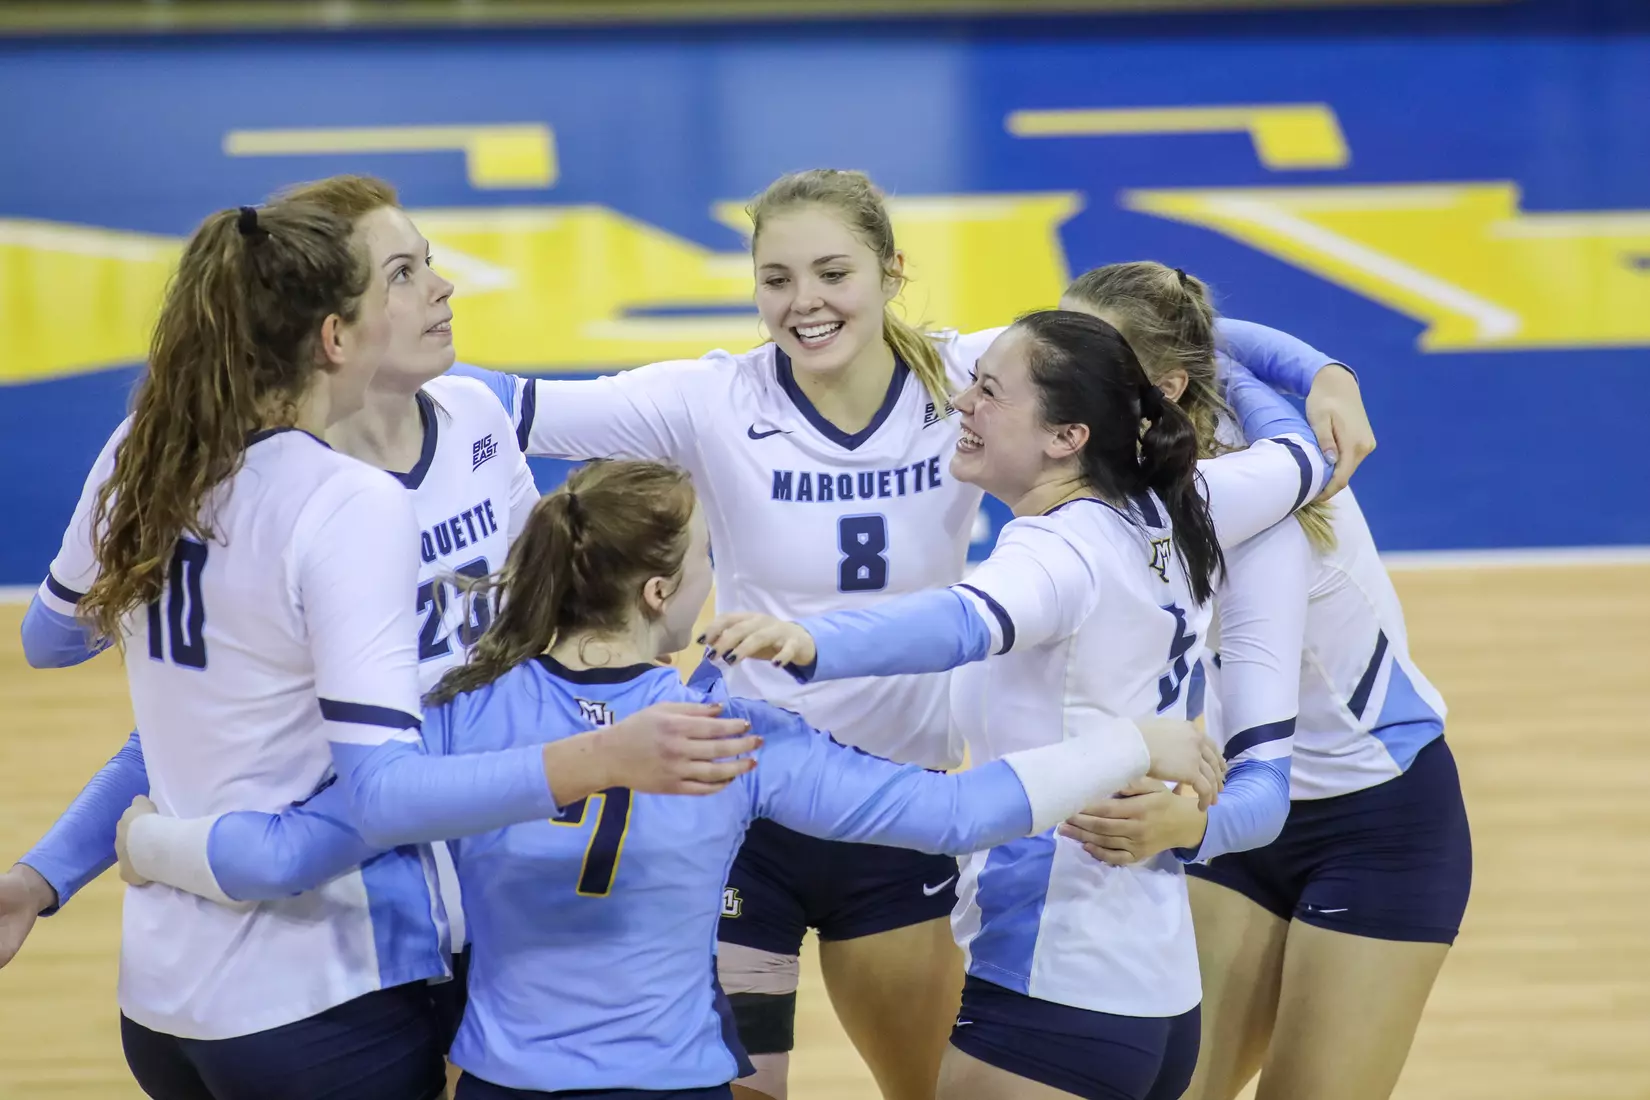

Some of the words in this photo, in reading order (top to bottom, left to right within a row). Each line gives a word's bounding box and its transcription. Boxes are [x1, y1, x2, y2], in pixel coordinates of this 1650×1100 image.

[472, 433, 492, 455] BIG
[472, 441, 499, 466] EAST
[771, 455, 943, 503] MARQUETTE
[420, 498, 498, 564] QUETTE
[837, 512, 890, 594] 8
[549, 785, 634, 897] 7
